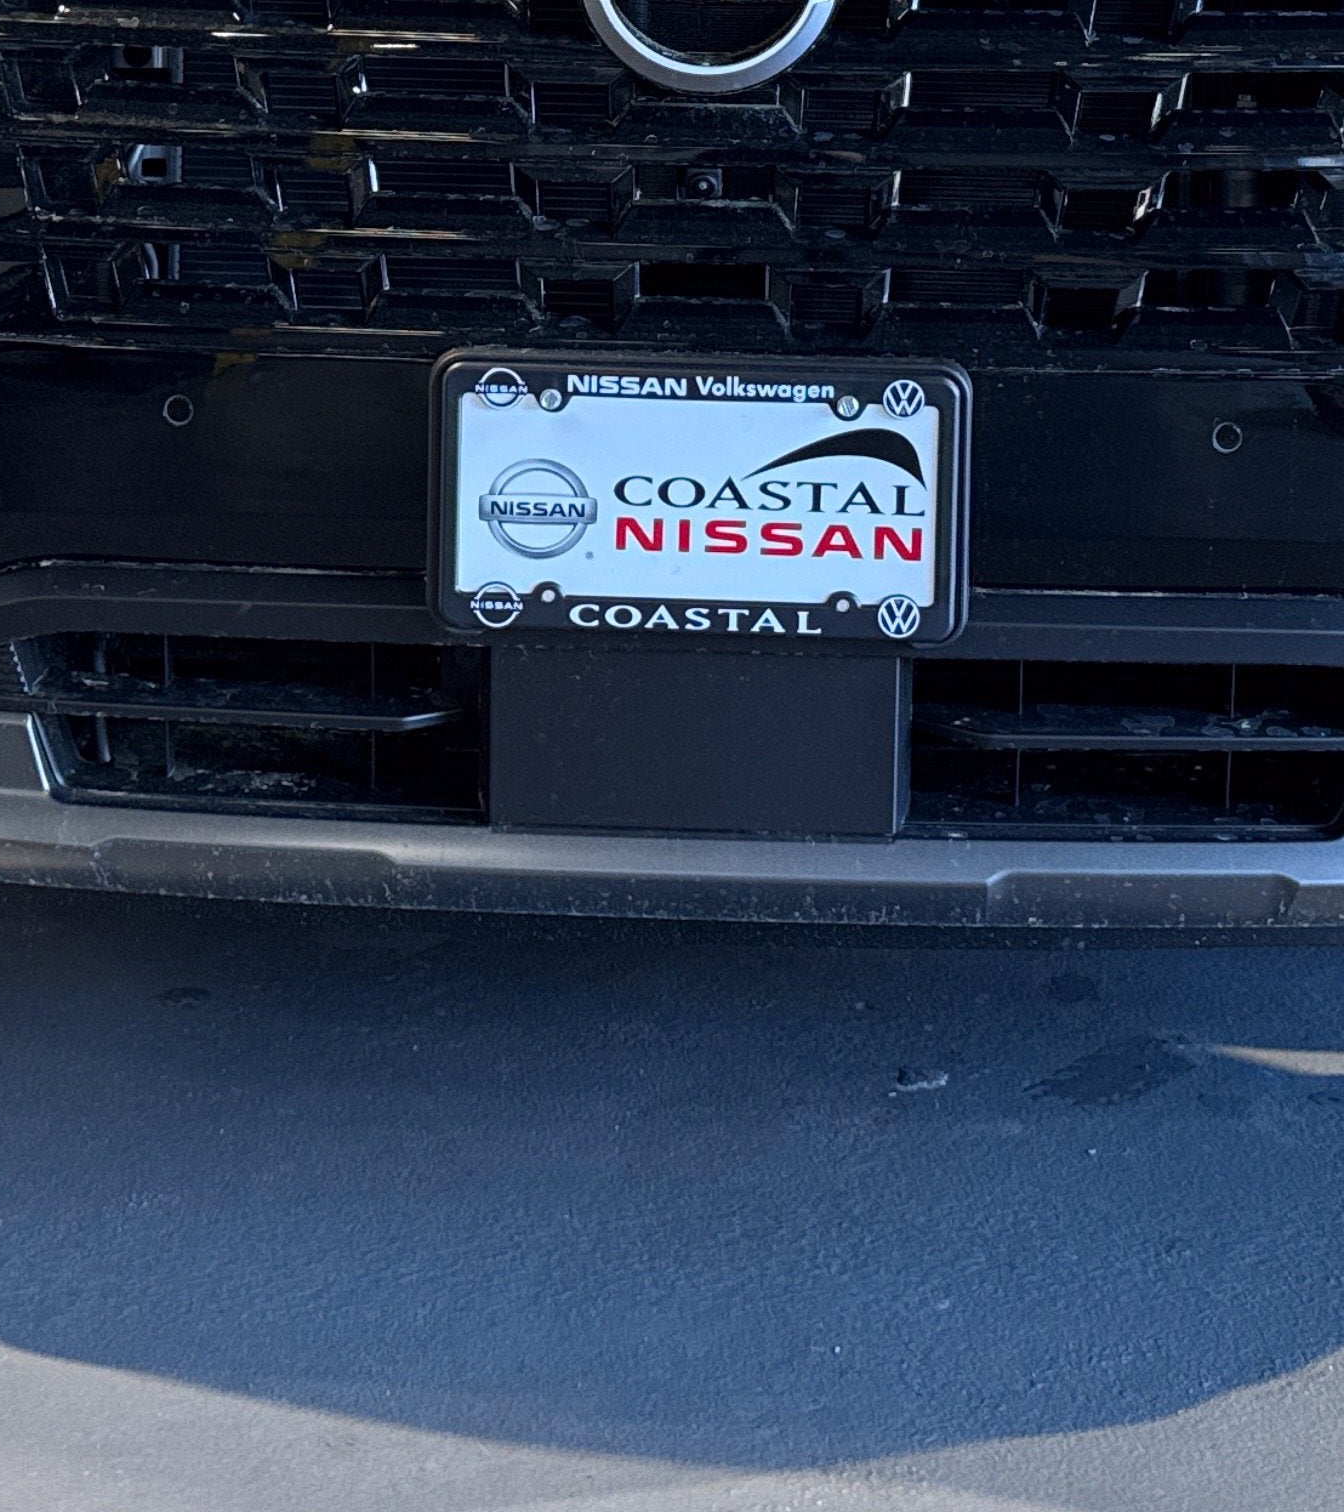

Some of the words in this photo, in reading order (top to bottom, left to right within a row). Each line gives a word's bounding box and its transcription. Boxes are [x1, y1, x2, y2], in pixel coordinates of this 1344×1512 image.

[475, 383, 528, 394] NISSAN
[566, 374, 687, 396] NISSAN
[695, 376, 834, 401] Volkswagen
[613, 475, 926, 516] COASTAL
[489, 501, 586, 518] NISSAN
[615, 516, 922, 561] NISSAN
[470, 599, 524, 611] NISSAN
[569, 604, 821, 635] COASTAL
